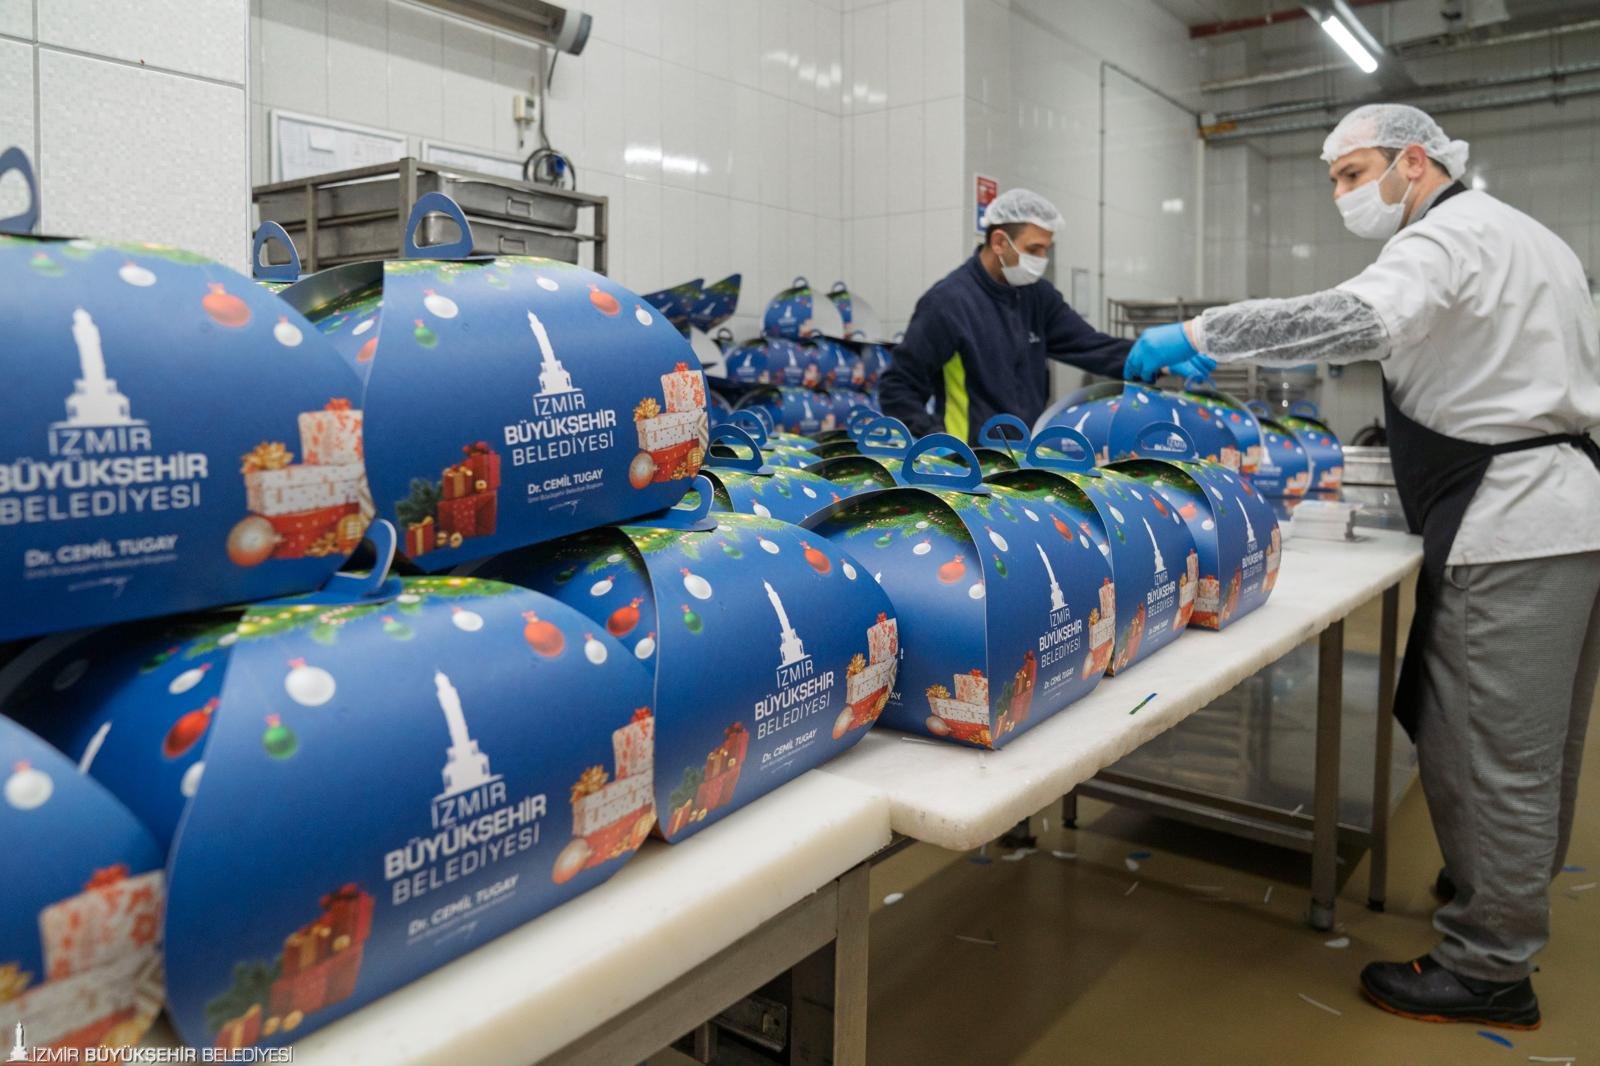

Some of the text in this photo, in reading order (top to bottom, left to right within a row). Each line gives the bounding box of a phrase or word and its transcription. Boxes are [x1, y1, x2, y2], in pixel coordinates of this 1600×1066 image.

[504, 409, 617, 445] BÜYÜKŞEHİR
[512, 430, 614, 467] BELEDİYESİ
[527, 483, 542, 495] Dr.
[543, 474, 572, 491] CEMİL
[573, 468, 604, 484] TUGAY
[0, 482, 201, 526] BELEDİYESİ
[117, 534, 178, 556] TUGAY
[1039, 619, 1083, 652] BÜYÜKŞEHİR
[1041, 636, 1081, 668] BELEDİYESİ
[754, 671, 835, 721] BÜYÜKŞEHİR
[757, 691, 831, 740] BELEDİYESİ
[795, 727, 818, 746] TUGAY
[384, 793, 547, 881] BÜYÜKŞEHİR
[392, 822, 540, 906] BELEDİYESİ
[475, 873, 520, 904] TUGAY
